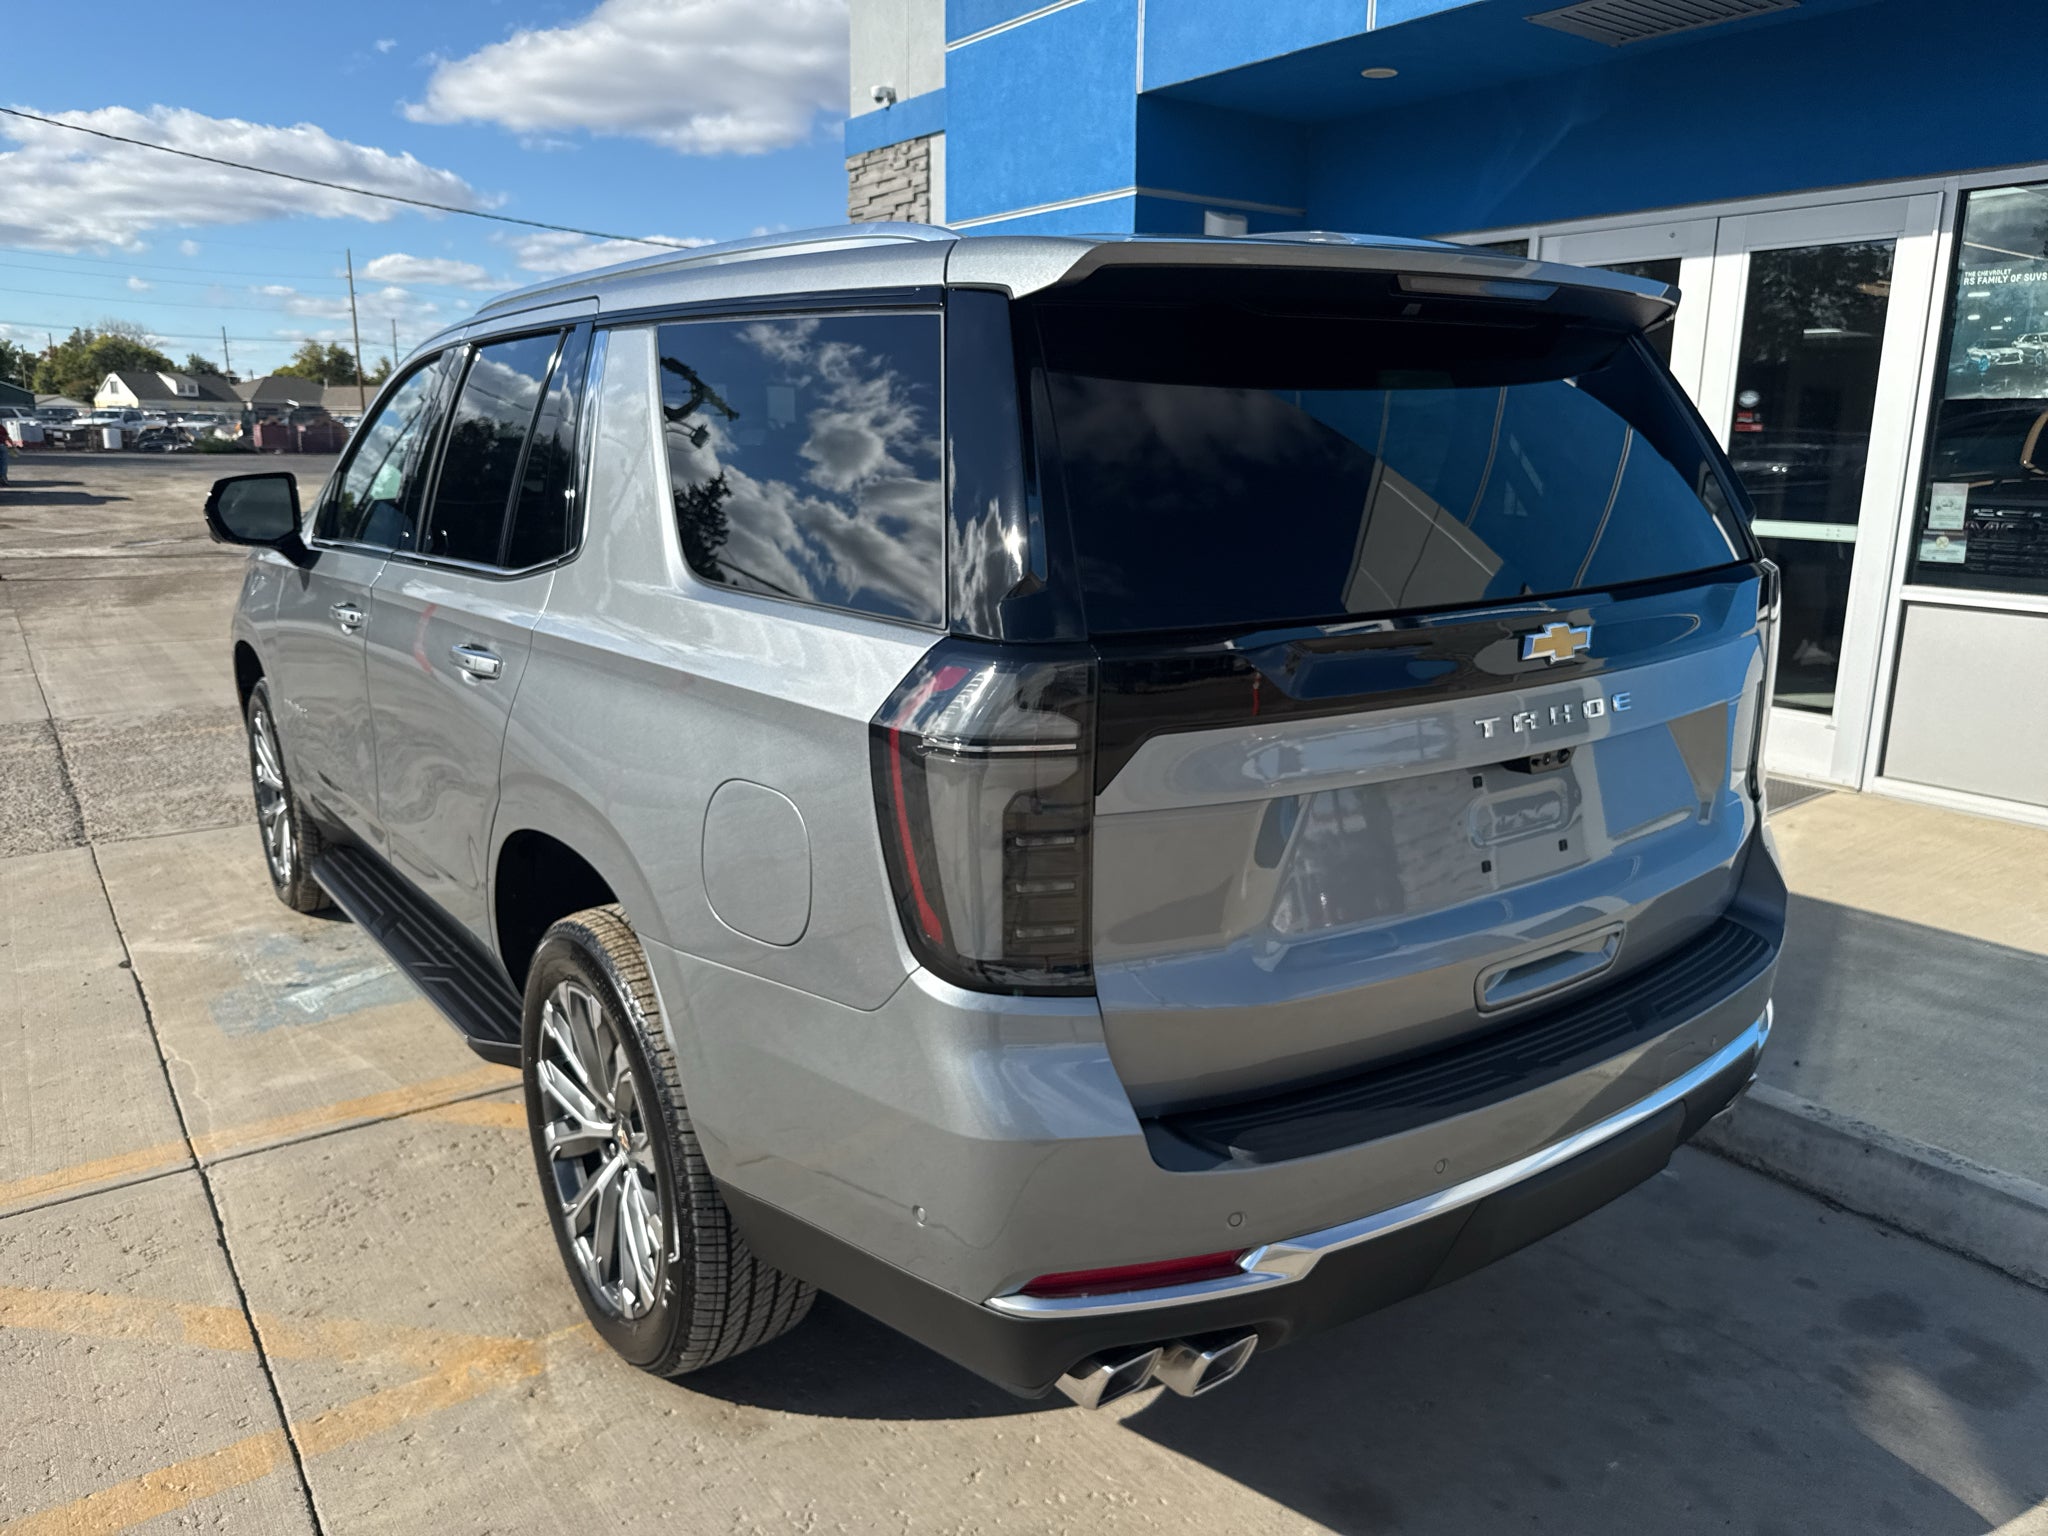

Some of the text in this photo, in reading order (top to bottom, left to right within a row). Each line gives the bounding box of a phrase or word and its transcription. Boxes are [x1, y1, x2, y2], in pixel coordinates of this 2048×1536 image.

[1963, 272, 2048, 285] RS FAMILY OF SUVS
[1977, 269, 2012, 277] CHEVROLET
[1474, 692, 1632, 738] TAHOE
